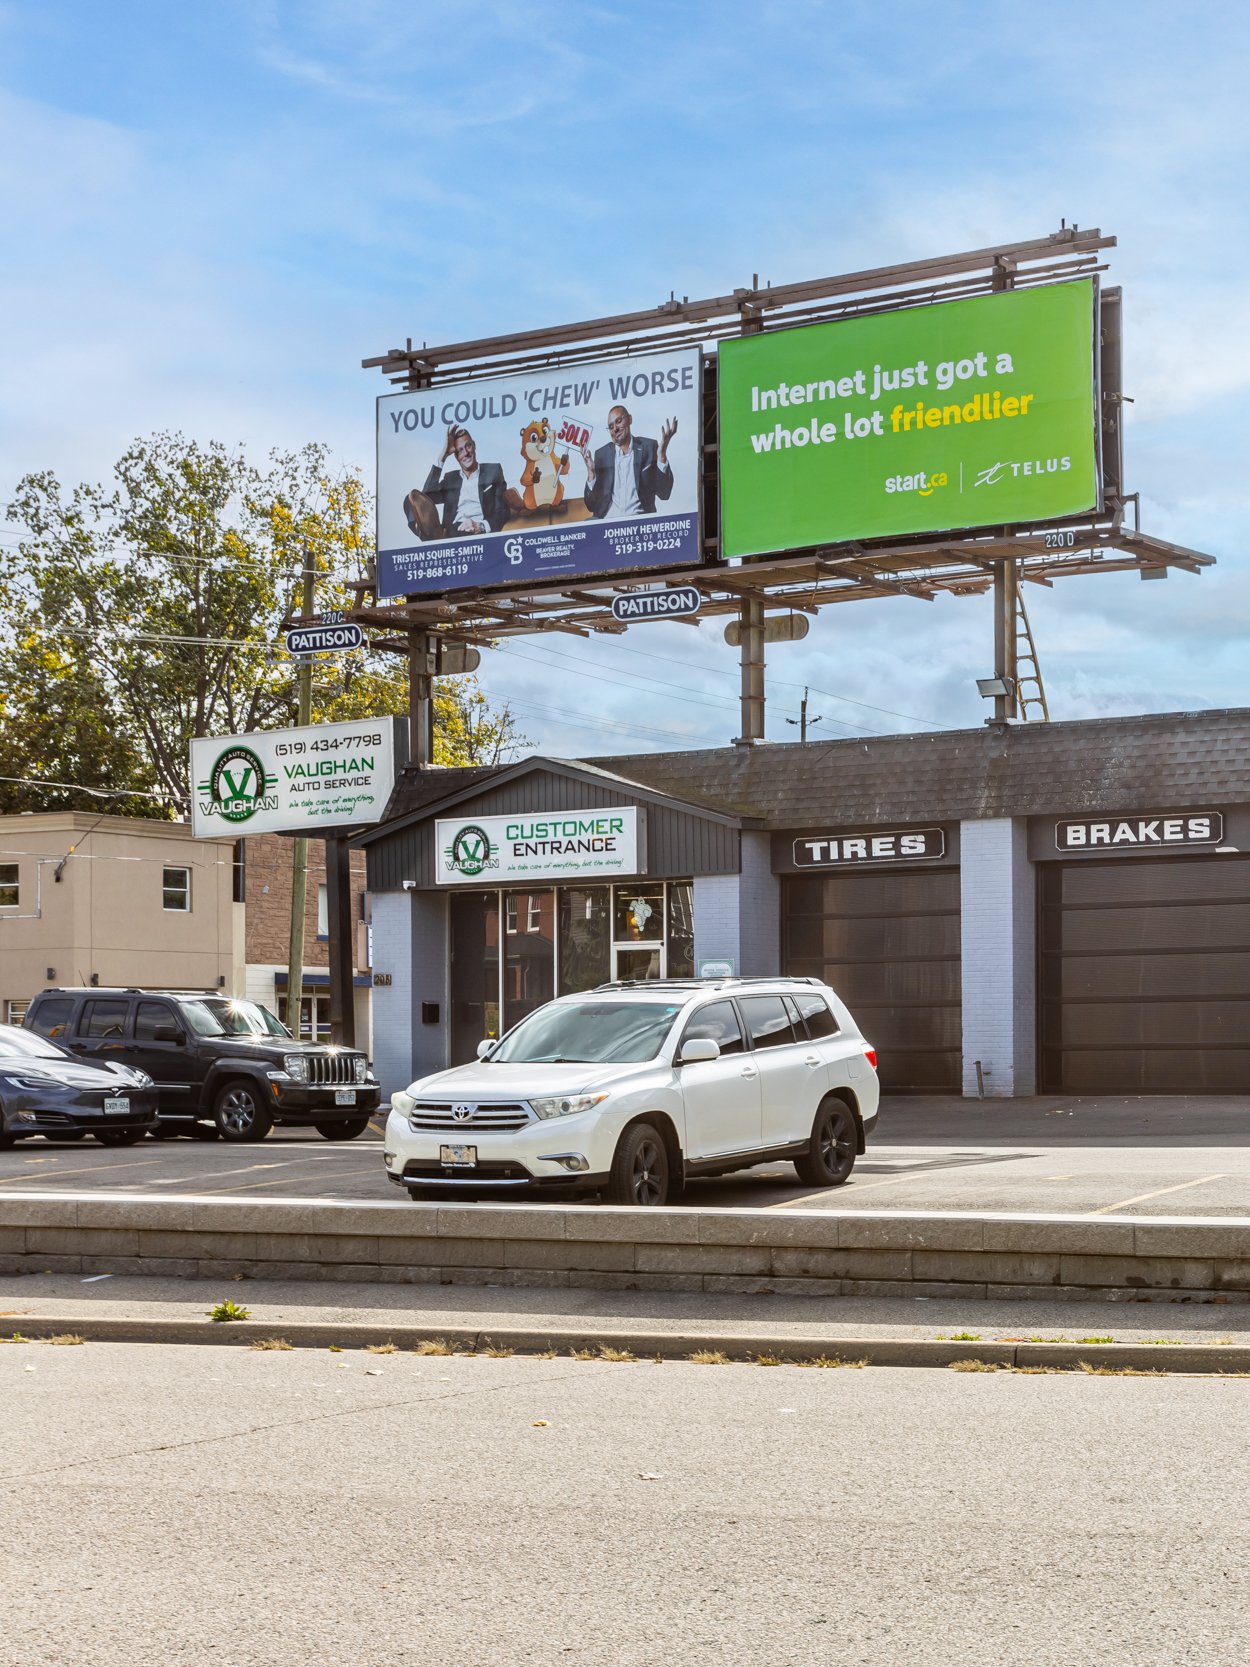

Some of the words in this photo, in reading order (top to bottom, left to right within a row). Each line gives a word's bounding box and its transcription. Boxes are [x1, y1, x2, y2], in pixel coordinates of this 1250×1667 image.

[751, 370, 866, 412] Internet
[870, 360, 928, 400] just
[935, 352, 987, 390] got
[995, 352, 1014, 374] a
[390, 406, 435, 433] YOU
[441, 393, 517, 425] COULD
[523, 380, 600, 413] 'CHEW'
[609, 366, 694, 400] WORSE
[750, 418, 837, 453] whole
[844, 410, 884, 439] lot
[890, 390, 1034, 432] friendlier
[557, 421, 589, 448] SOLD
[1010, 456, 1071, 477] TELUS
[885, 471, 948, 494] start.ca
[524, 536, 559, 546] COLDWELL
[560, 532, 587, 542] BANKER
[603, 526, 638, 539] JOHNNY
[640, 520, 691, 534] HEWERDINE
[609, 535, 640, 545] BROKER
[643, 533, 653, 541] OF
[657, 530, 689, 539] RECORD
[615, 538, 681, 555] 519-319-0224
[1045, 533, 1064, 548] 220
[1067, 532, 1074, 546] D
[392, 552, 425, 564] TRISTAN
[426, 545, 484, 560] SQUIRE-SMITH
[394, 563, 417, 571] SALES
[420, 555, 483, 568] REPRESENTATIVE
[407, 564, 468, 580] 519-868-6119
[618, 592, 694, 616] PATTISON
[291, 629, 357, 649] PATTISON
[275, 741, 306, 756] (519)
[310, 734, 382, 752] 434-7798
[283, 756, 375, 779] VAUGHAN
[289, 781, 320, 793] AUTO
[324, 776, 371, 789] SERVICE
[199, 795, 279, 816] VAUGHAN
[307, 808, 318, 816] but
[321, 806, 332, 814] the
[506, 817, 624, 841] CUSTOMER
[1066, 818, 1210, 845] BRAKES
[513, 837, 616, 857] ENTRANCE
[805, 834, 926, 861] TIRES
[445, 859, 499, 871] VAUGHAN
